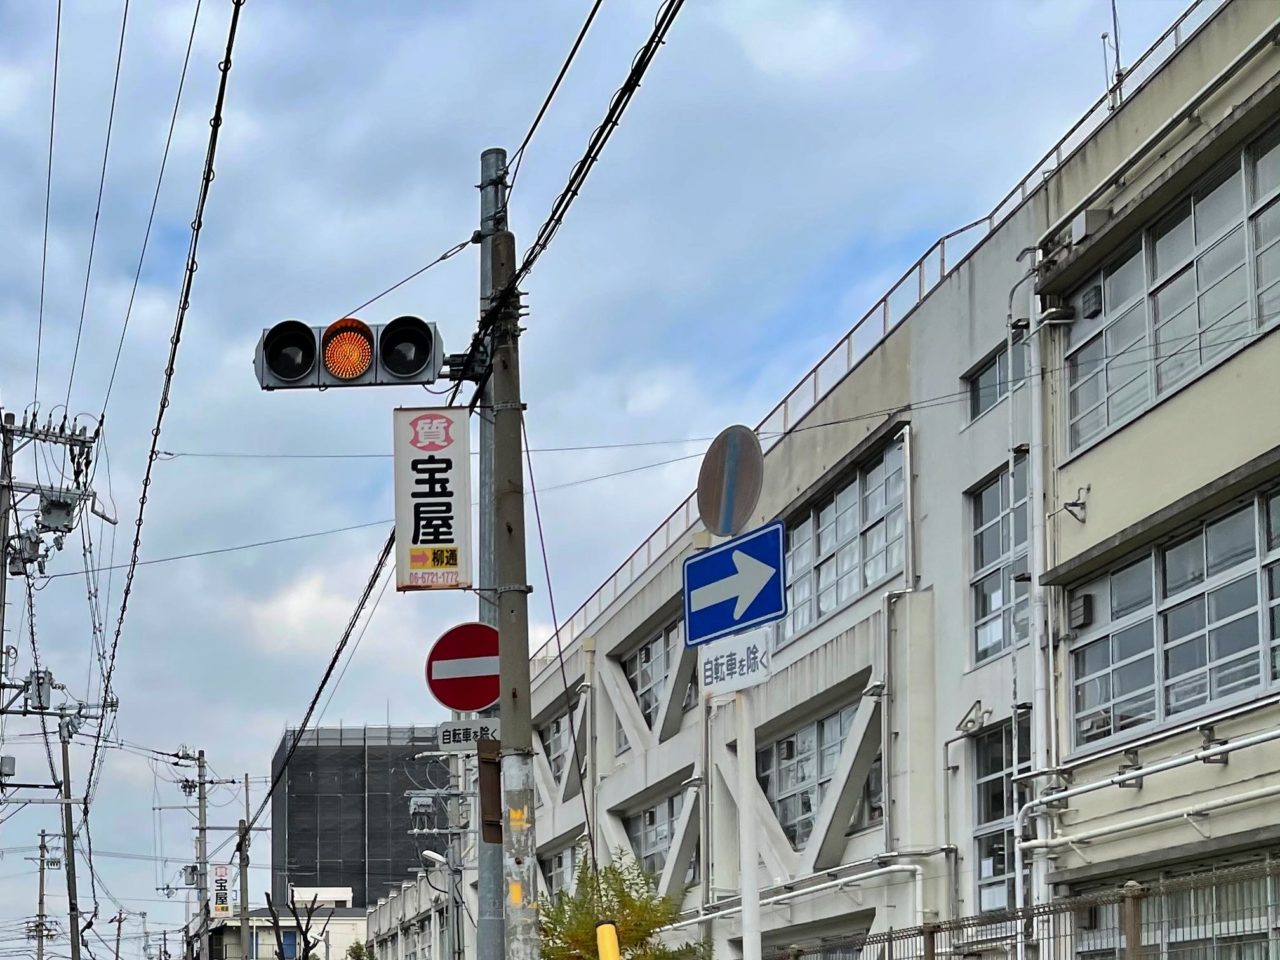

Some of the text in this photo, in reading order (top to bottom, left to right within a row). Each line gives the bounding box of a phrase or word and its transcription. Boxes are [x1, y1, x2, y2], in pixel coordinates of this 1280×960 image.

[411, 455, 454, 545] 宝屋
[432, 549, 458, 567] 柳通
[409, 572, 459, 584] 06-6721-1772
[703, 644, 768, 687] 自転車を除く
